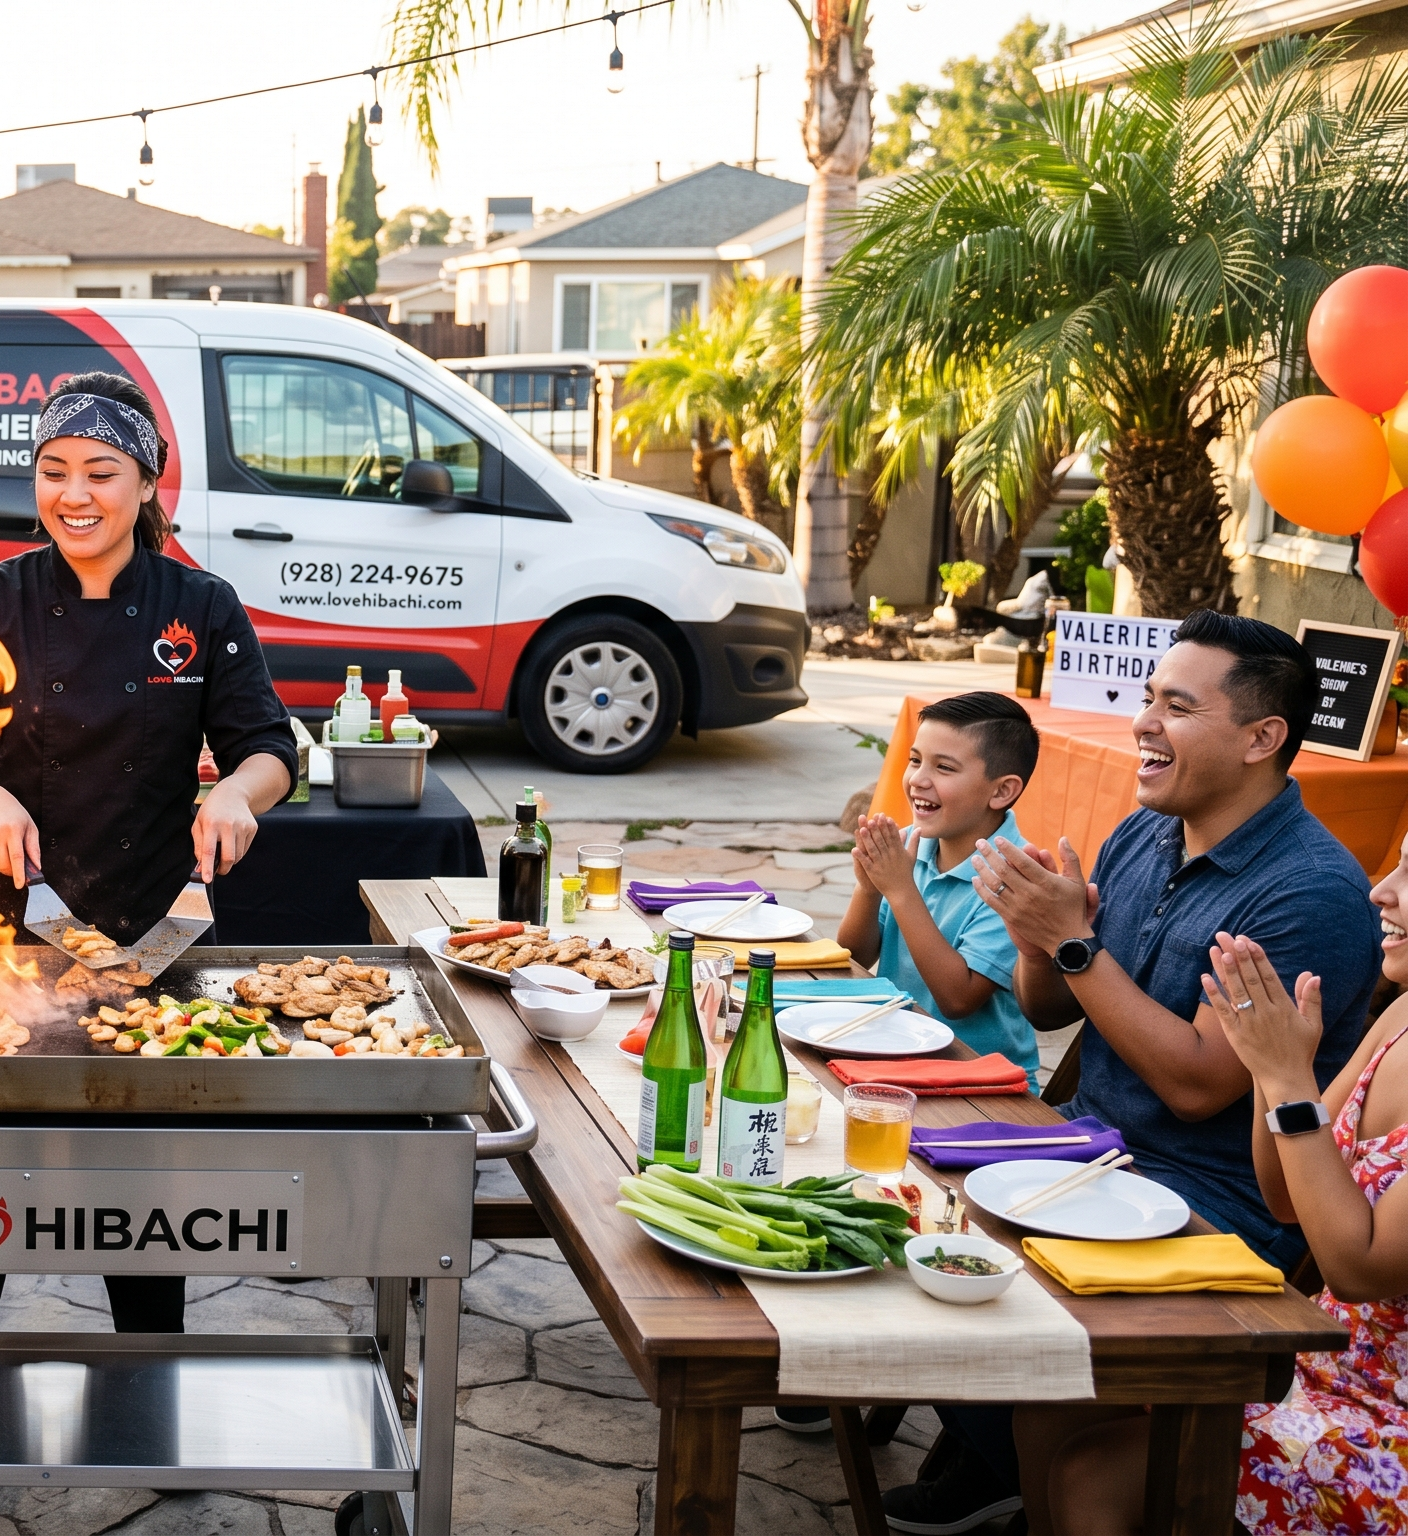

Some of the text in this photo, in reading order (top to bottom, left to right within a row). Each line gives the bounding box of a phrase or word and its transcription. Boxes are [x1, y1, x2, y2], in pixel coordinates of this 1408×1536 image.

[280, 562, 464, 587] (928) 224-9675
[279, 591, 463, 610] www.lovehibachi.com
[25, 1207, 289, 1252] HIBACHI
